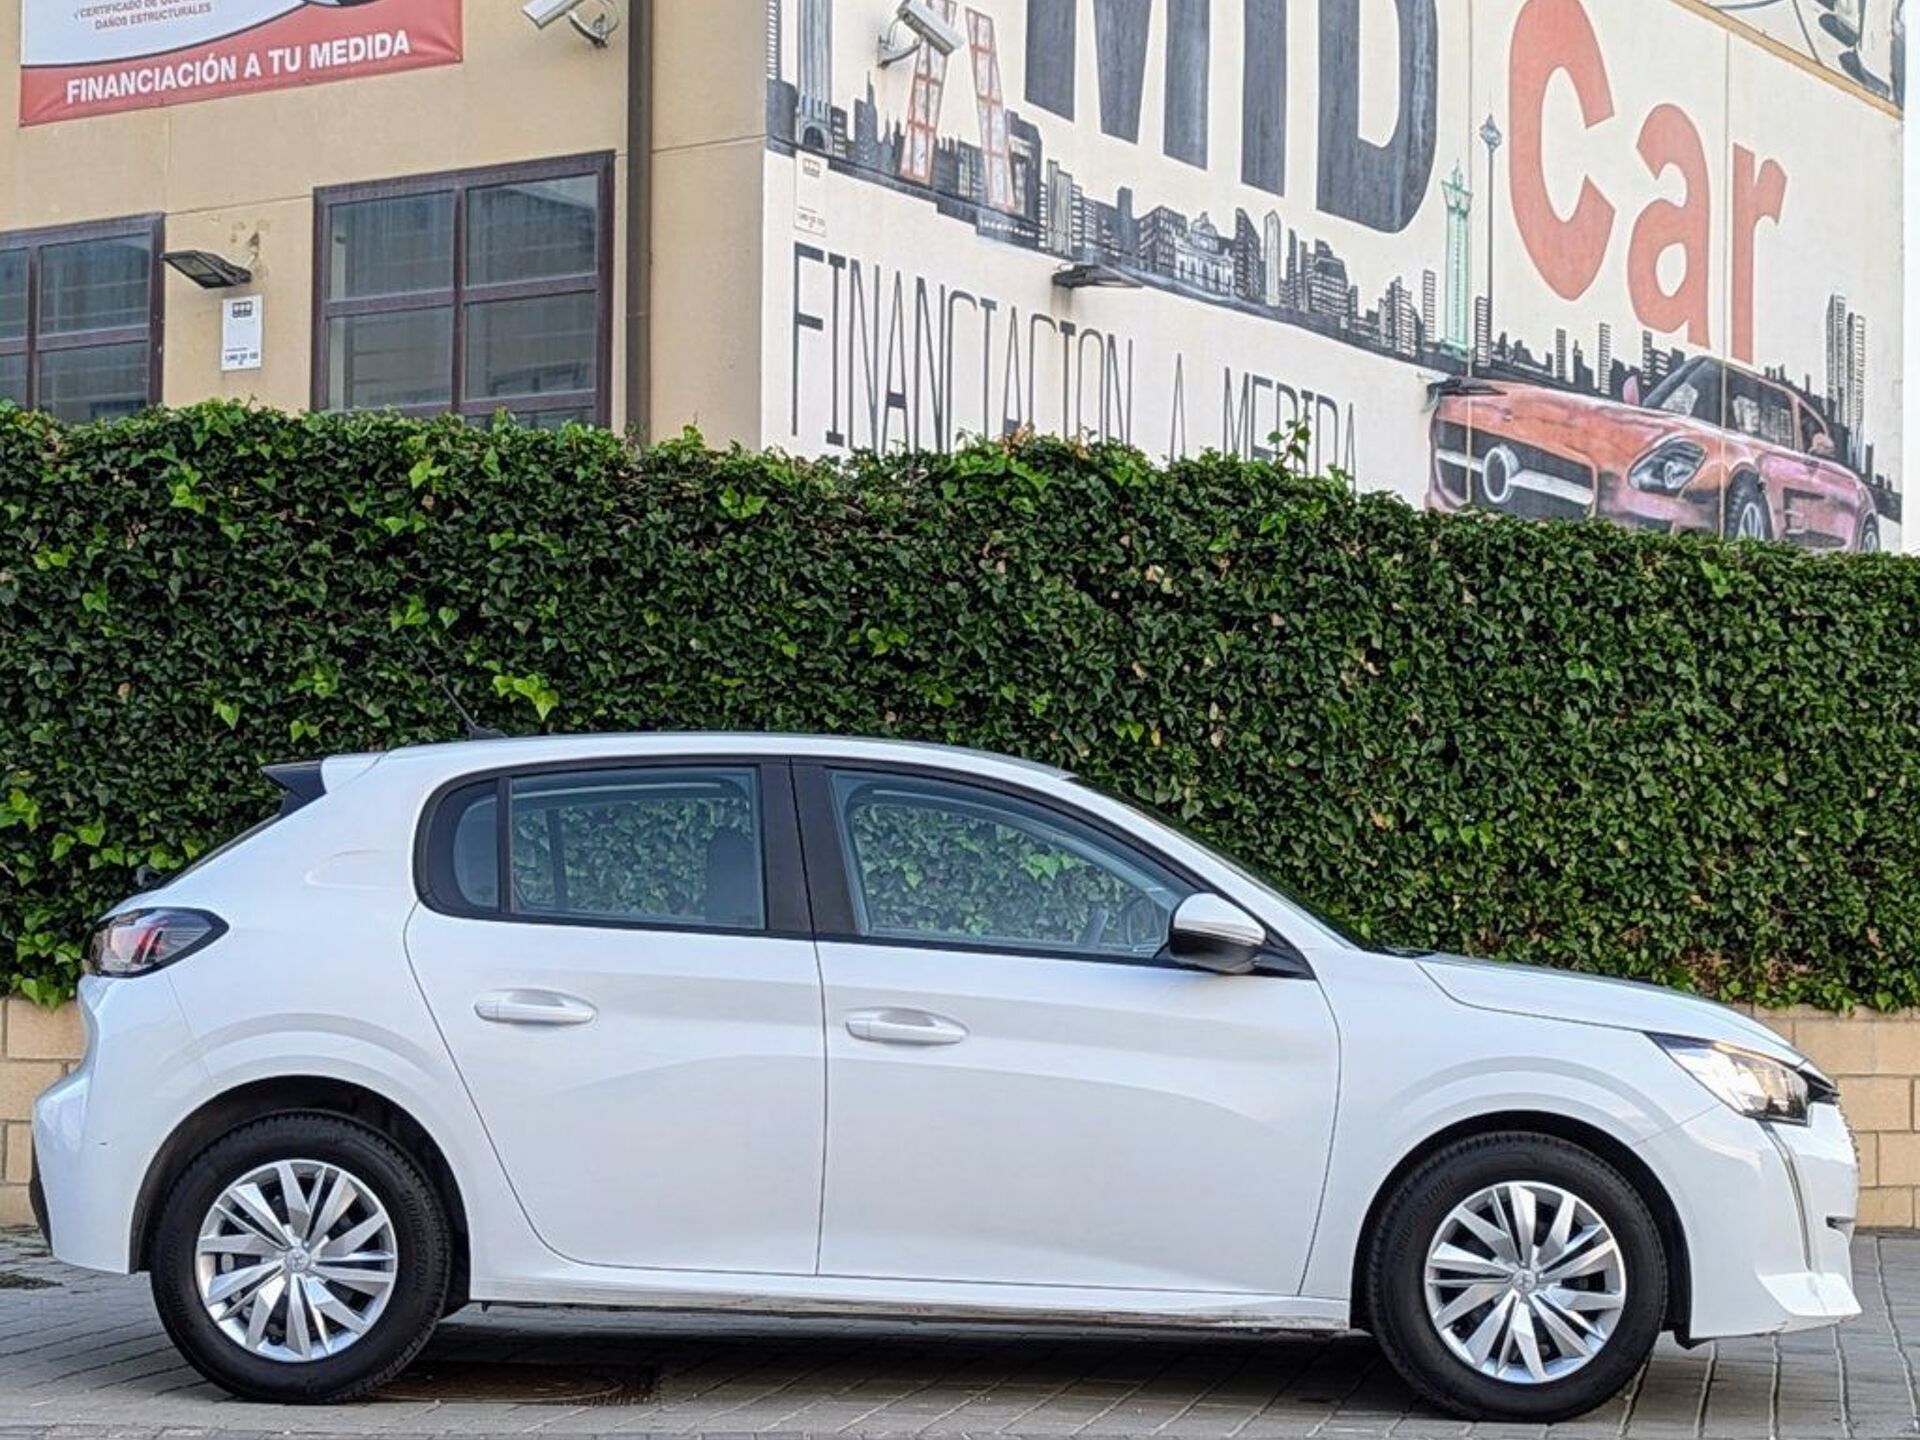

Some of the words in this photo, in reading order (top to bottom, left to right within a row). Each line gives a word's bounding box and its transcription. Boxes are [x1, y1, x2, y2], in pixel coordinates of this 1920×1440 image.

[79, 0, 142, 18] CERTIFICADO
[95, 16, 128, 29] DAÑOS
[130, 3, 212, 24] ESTRUCTURALES
[66, 53, 237, 104] FINANCIACIÓN
[243, 52, 262, 79] A
[268, 45, 302, 75] TU
[309, 29, 411, 70] MEDIDA
[1508, 0, 1788, 365] Car
